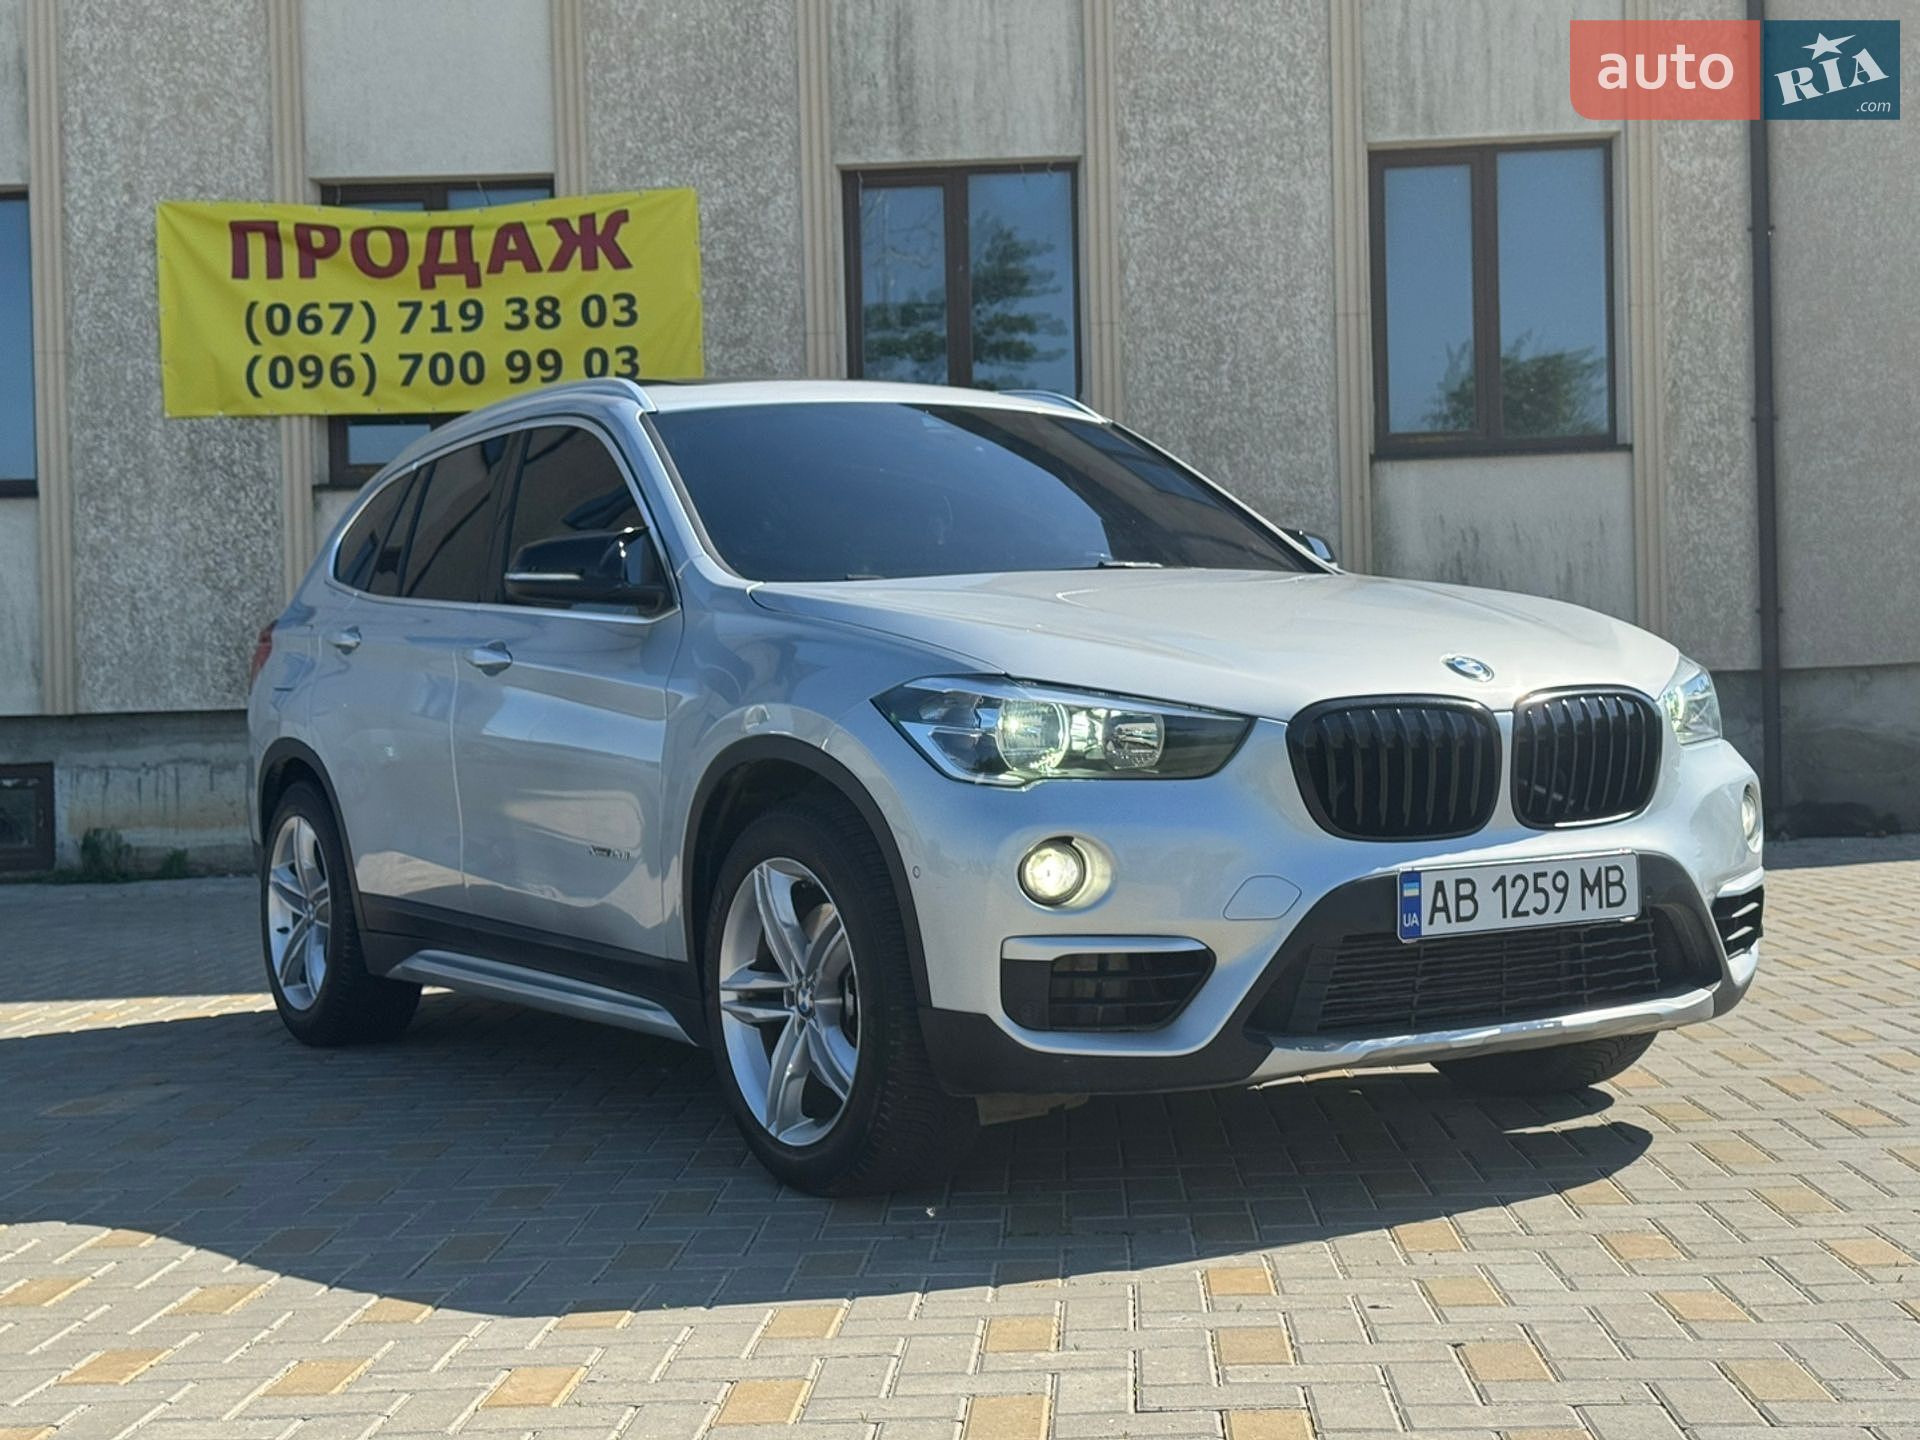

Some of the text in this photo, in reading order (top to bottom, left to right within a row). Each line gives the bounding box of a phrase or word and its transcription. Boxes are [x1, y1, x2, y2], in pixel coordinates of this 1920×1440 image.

[229, 209, 633, 290] ПРОДАЖ
[245, 293, 639, 346] (067) 719 38 03
[245, 345, 640, 398] (096) 700 99 03
[1403, 913, 1419, 927] UA
[1428, 864, 1628, 926] AB 1259 MB
